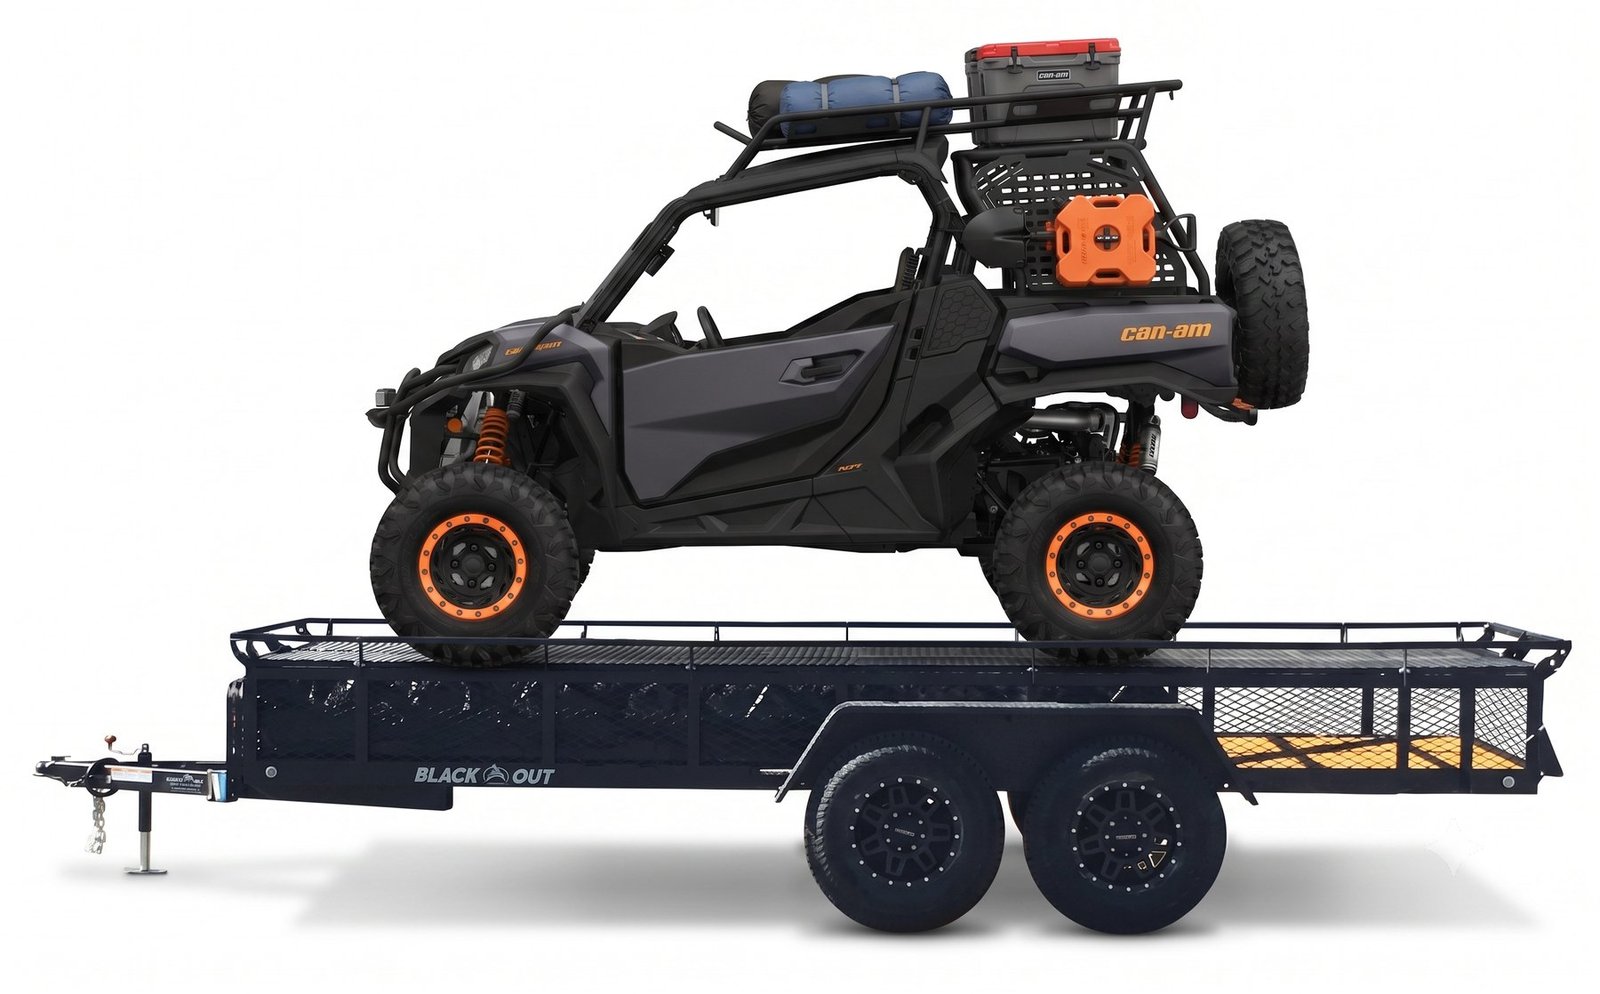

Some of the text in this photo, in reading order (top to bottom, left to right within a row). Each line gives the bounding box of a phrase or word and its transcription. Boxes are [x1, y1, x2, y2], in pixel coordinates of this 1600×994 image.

[1120, 323, 1212, 342] can-am
[414, 767, 555, 785] BLACK OUT
